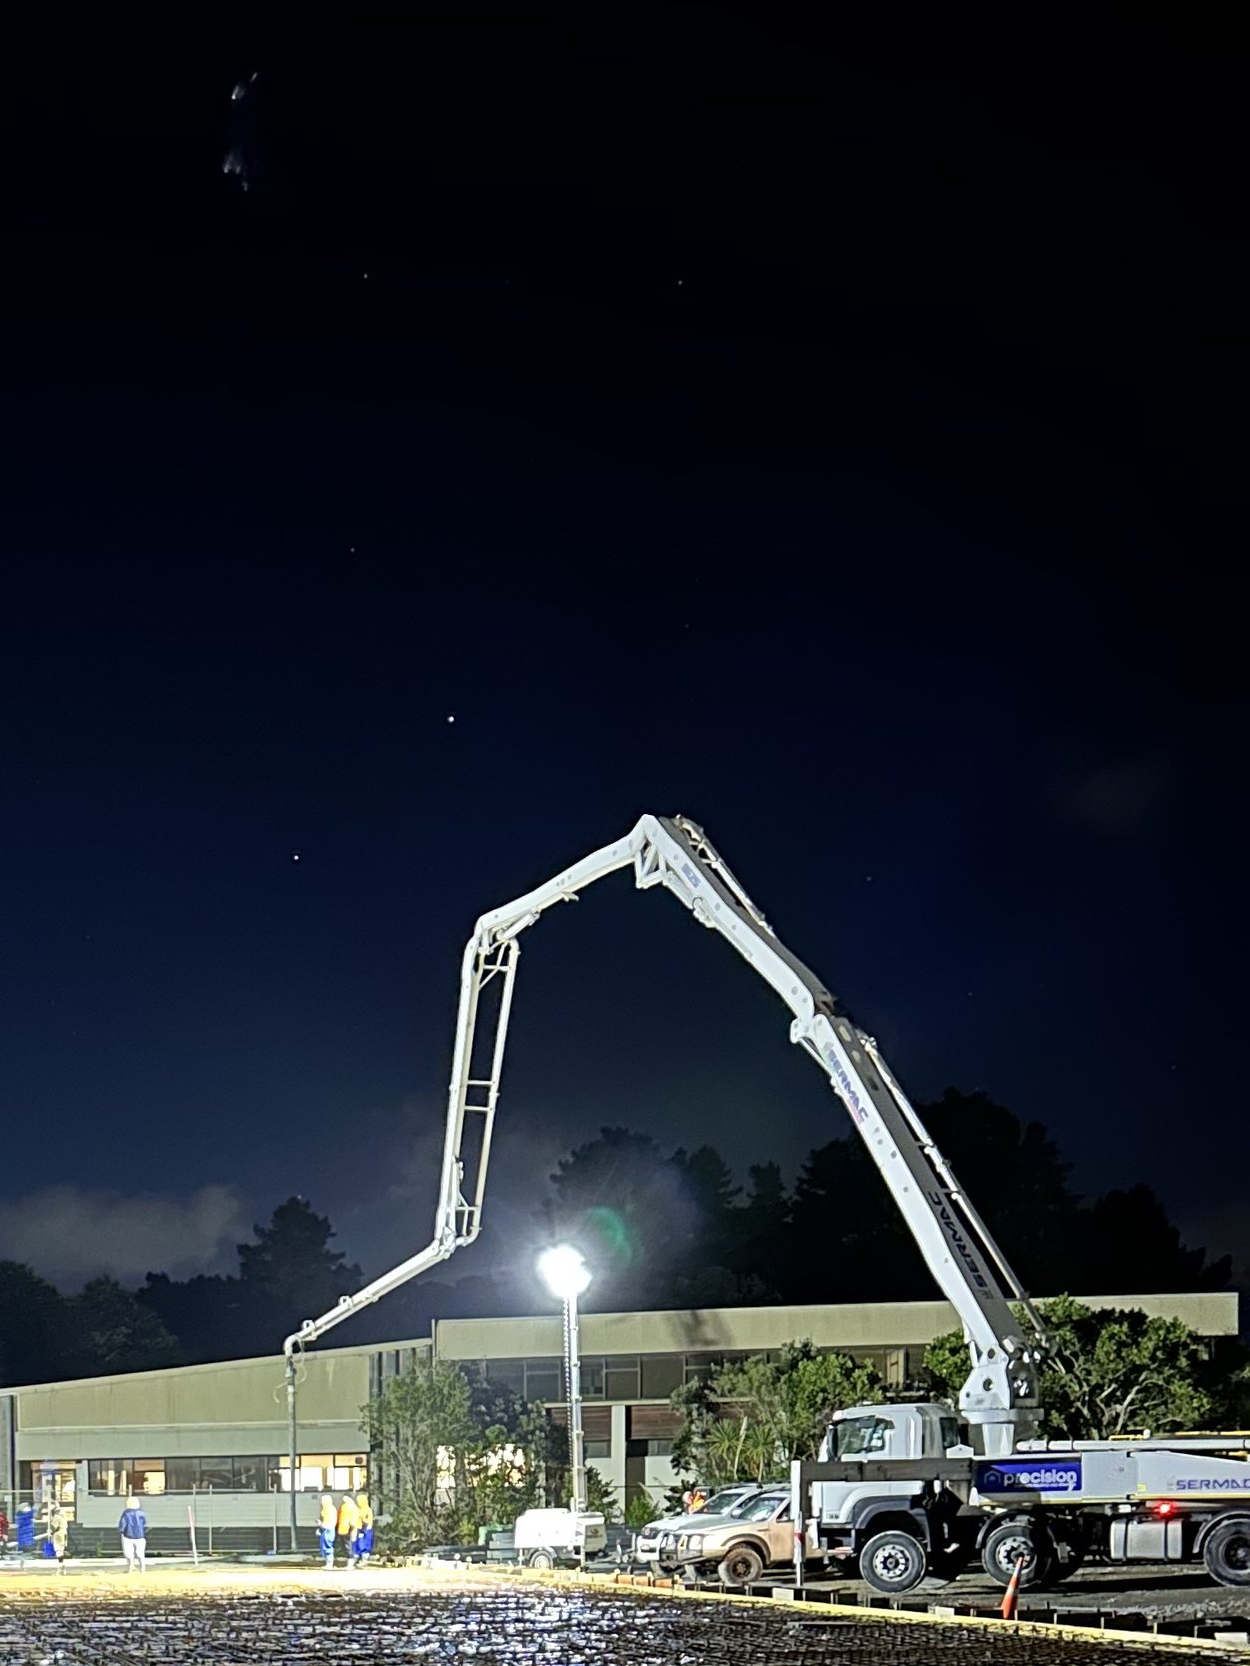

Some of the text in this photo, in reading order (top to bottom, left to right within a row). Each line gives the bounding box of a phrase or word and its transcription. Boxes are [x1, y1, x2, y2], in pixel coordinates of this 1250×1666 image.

[828, 1049, 869, 1121] SERMAC
[928, 1191, 988, 1288] SERMAC
[1004, 1469, 1077, 1490] precision
